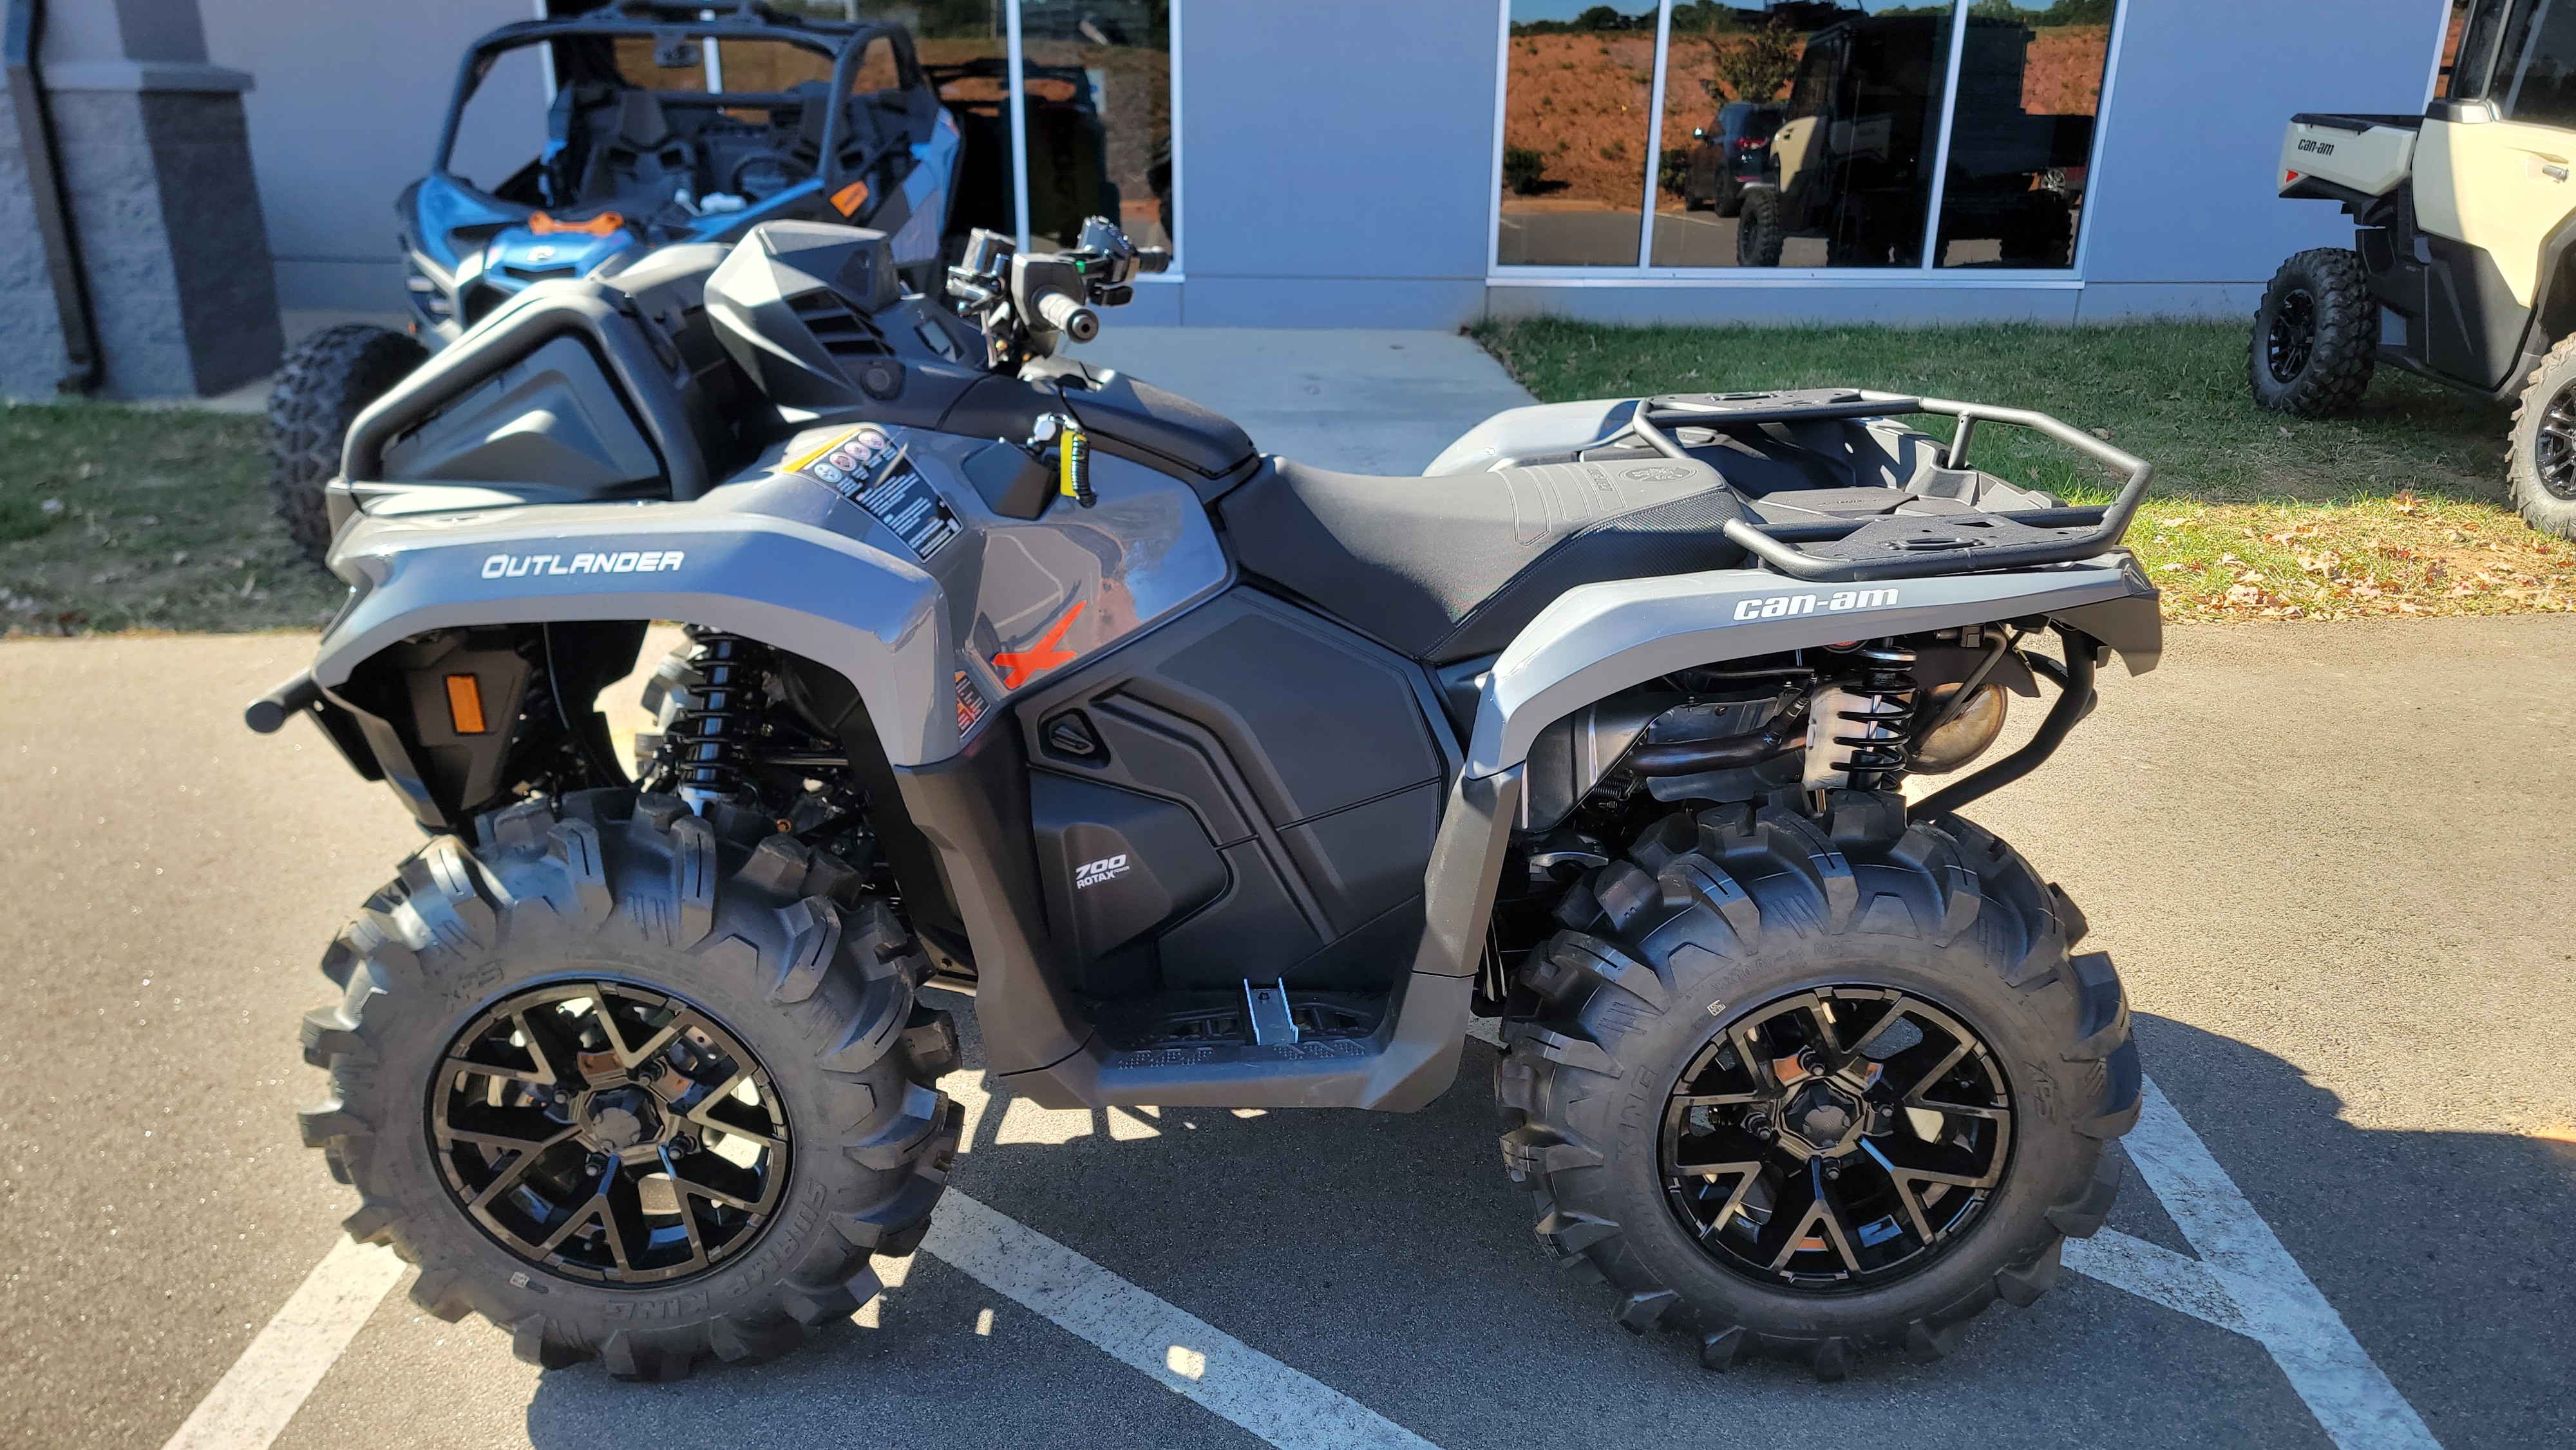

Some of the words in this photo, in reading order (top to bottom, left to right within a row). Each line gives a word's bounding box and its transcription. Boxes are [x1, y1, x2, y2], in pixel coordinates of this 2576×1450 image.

[2297, 138, 2334, 156] can-am
[481, 551, 685, 579] OUTLANDER
[1732, 588, 1900, 621] can-am
[1075, 854, 1127, 880] 700
[1076, 869, 1115, 890] ROTAX
[1113, 865, 1130, 874] POWER
